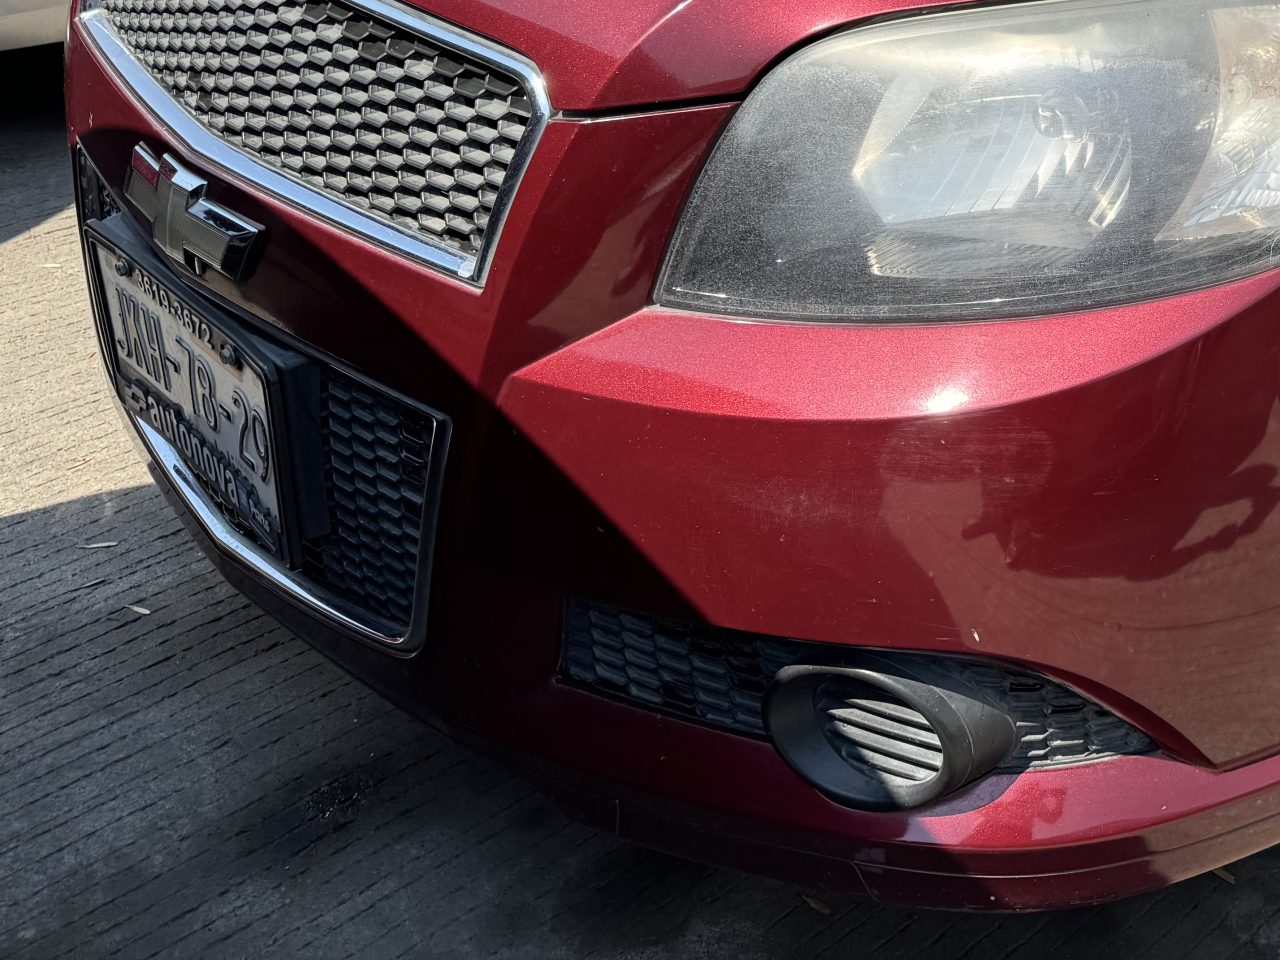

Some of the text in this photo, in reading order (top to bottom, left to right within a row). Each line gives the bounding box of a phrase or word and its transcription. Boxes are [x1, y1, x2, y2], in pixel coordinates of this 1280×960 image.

[136, 268, 214, 350] 3619-3672
[114, 287, 270, 483] JKH-78-29
[146, 396, 240, 507] autonova
